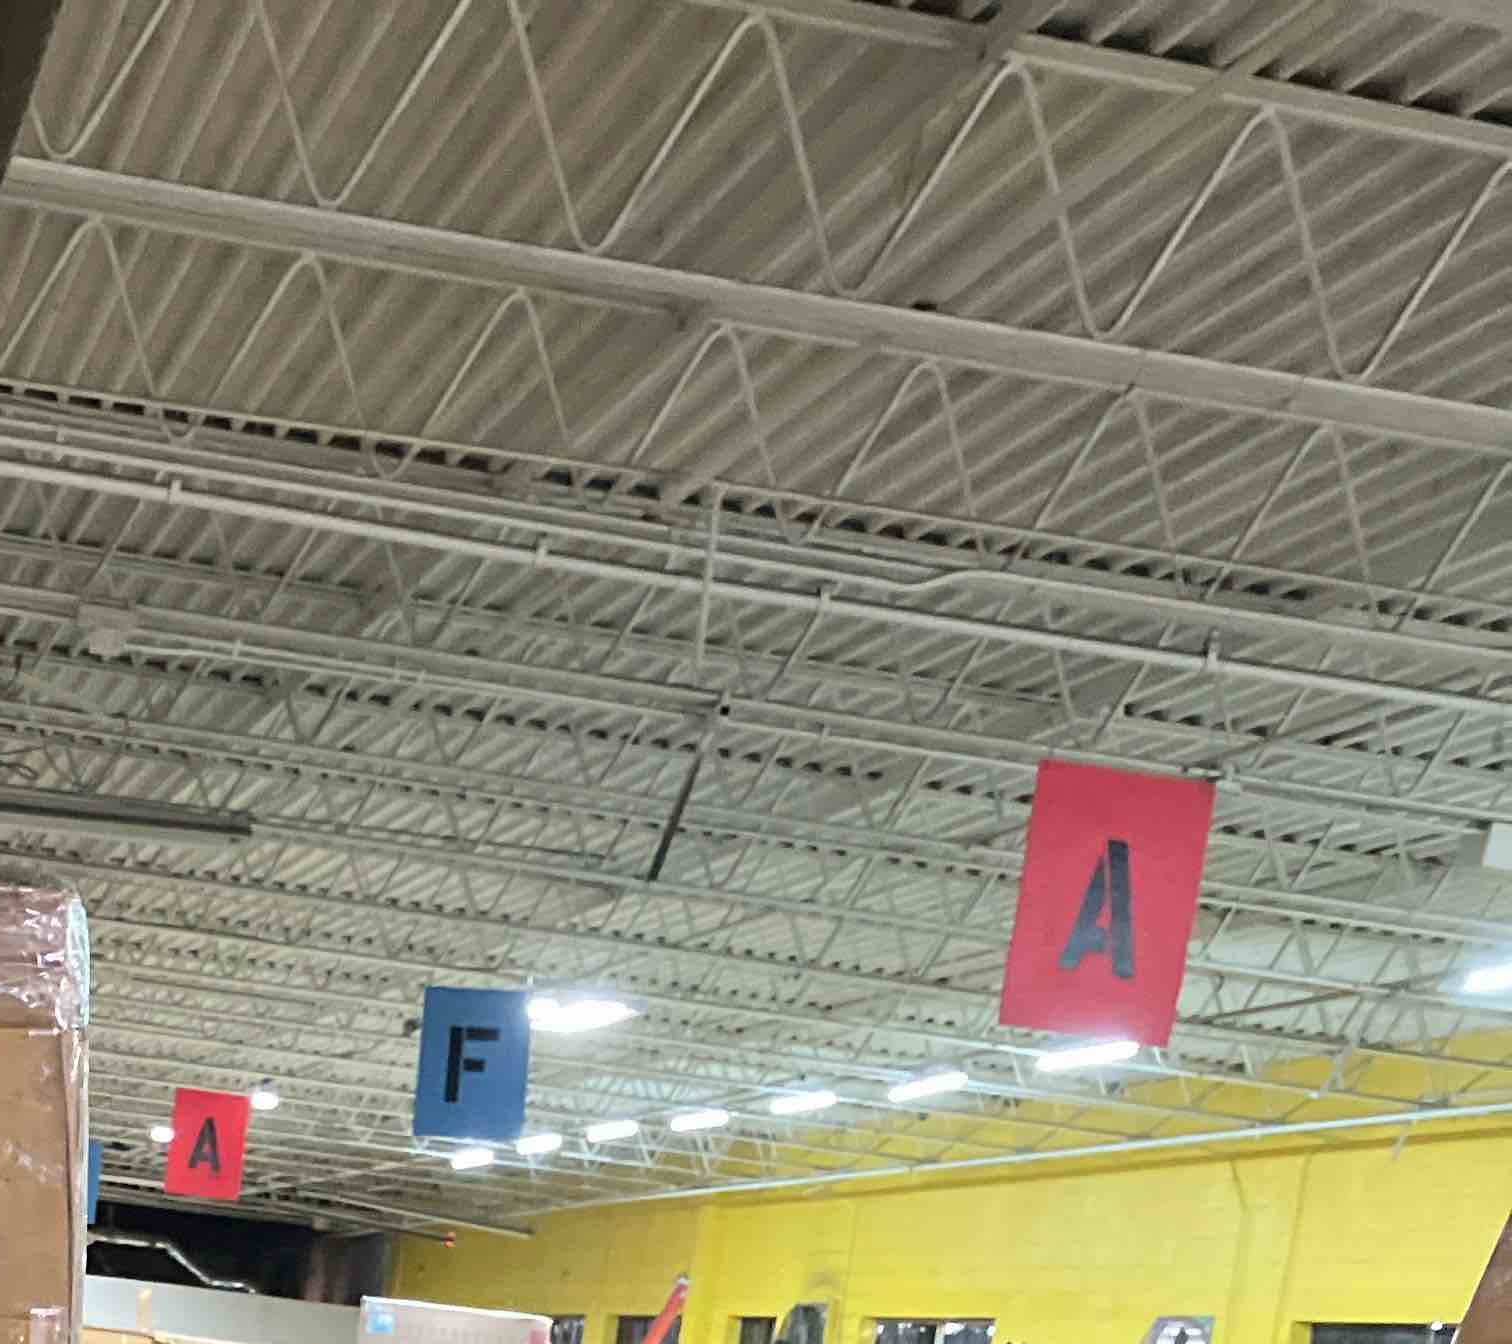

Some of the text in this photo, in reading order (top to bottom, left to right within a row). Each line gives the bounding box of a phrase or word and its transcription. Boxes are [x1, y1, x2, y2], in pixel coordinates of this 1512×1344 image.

[1059, 838, 1136, 980] A
[444, 1026, 501, 1104] F
[188, 1117, 221, 1178] A
